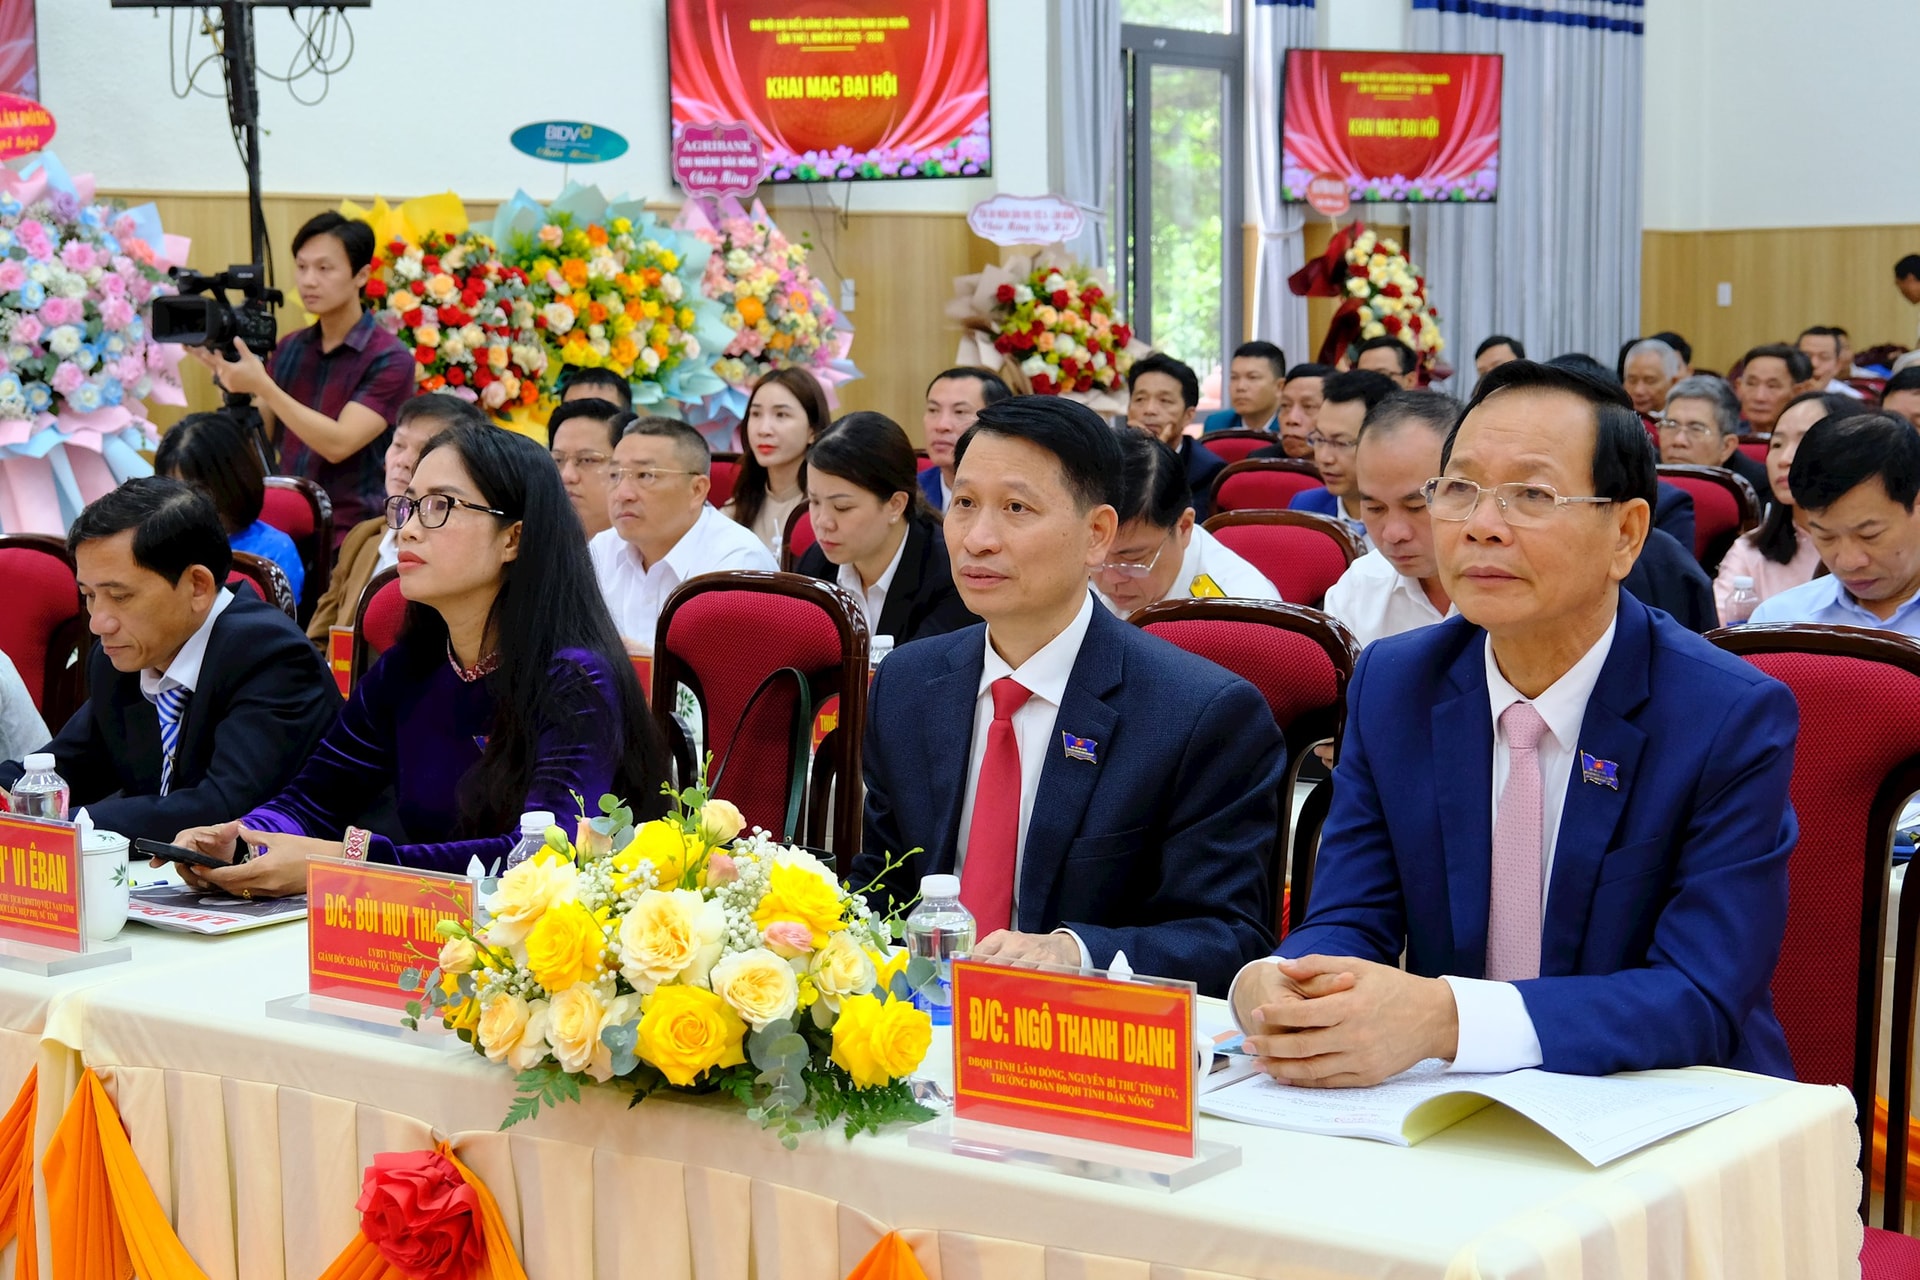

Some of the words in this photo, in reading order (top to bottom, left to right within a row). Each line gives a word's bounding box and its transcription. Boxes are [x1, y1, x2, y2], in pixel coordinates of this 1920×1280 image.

[766, 76, 803, 99] KHAI
[806, 75, 840, 101] MẠC
[842, 75, 869, 101] ĐẠI
[871, 70, 897, 100] HỘI
[545, 124, 581, 142] BIDV
[682, 140, 752, 152] AGRIBANK
[12, 847, 26, 887] VI
[30, 841, 68, 894] ÊBAN
[324, 893, 352, 929] Đ/C:
[355, 892, 379, 933] BÙI
[382, 902, 409, 938] HUY
[412, 902, 459, 945] THÀ
[969, 996, 1009, 1044] Đ/C:
[1014, 1002, 1053, 1050] NGÔ
[1057, 1012, 1119, 1061] THANH
[1124, 1022, 1176, 1070] DANH
[1017, 1062, 1037, 1076] LÂM
[1118, 1079, 1138, 1092] THƯ
[1127, 1093, 1155, 1109] NÔNG
